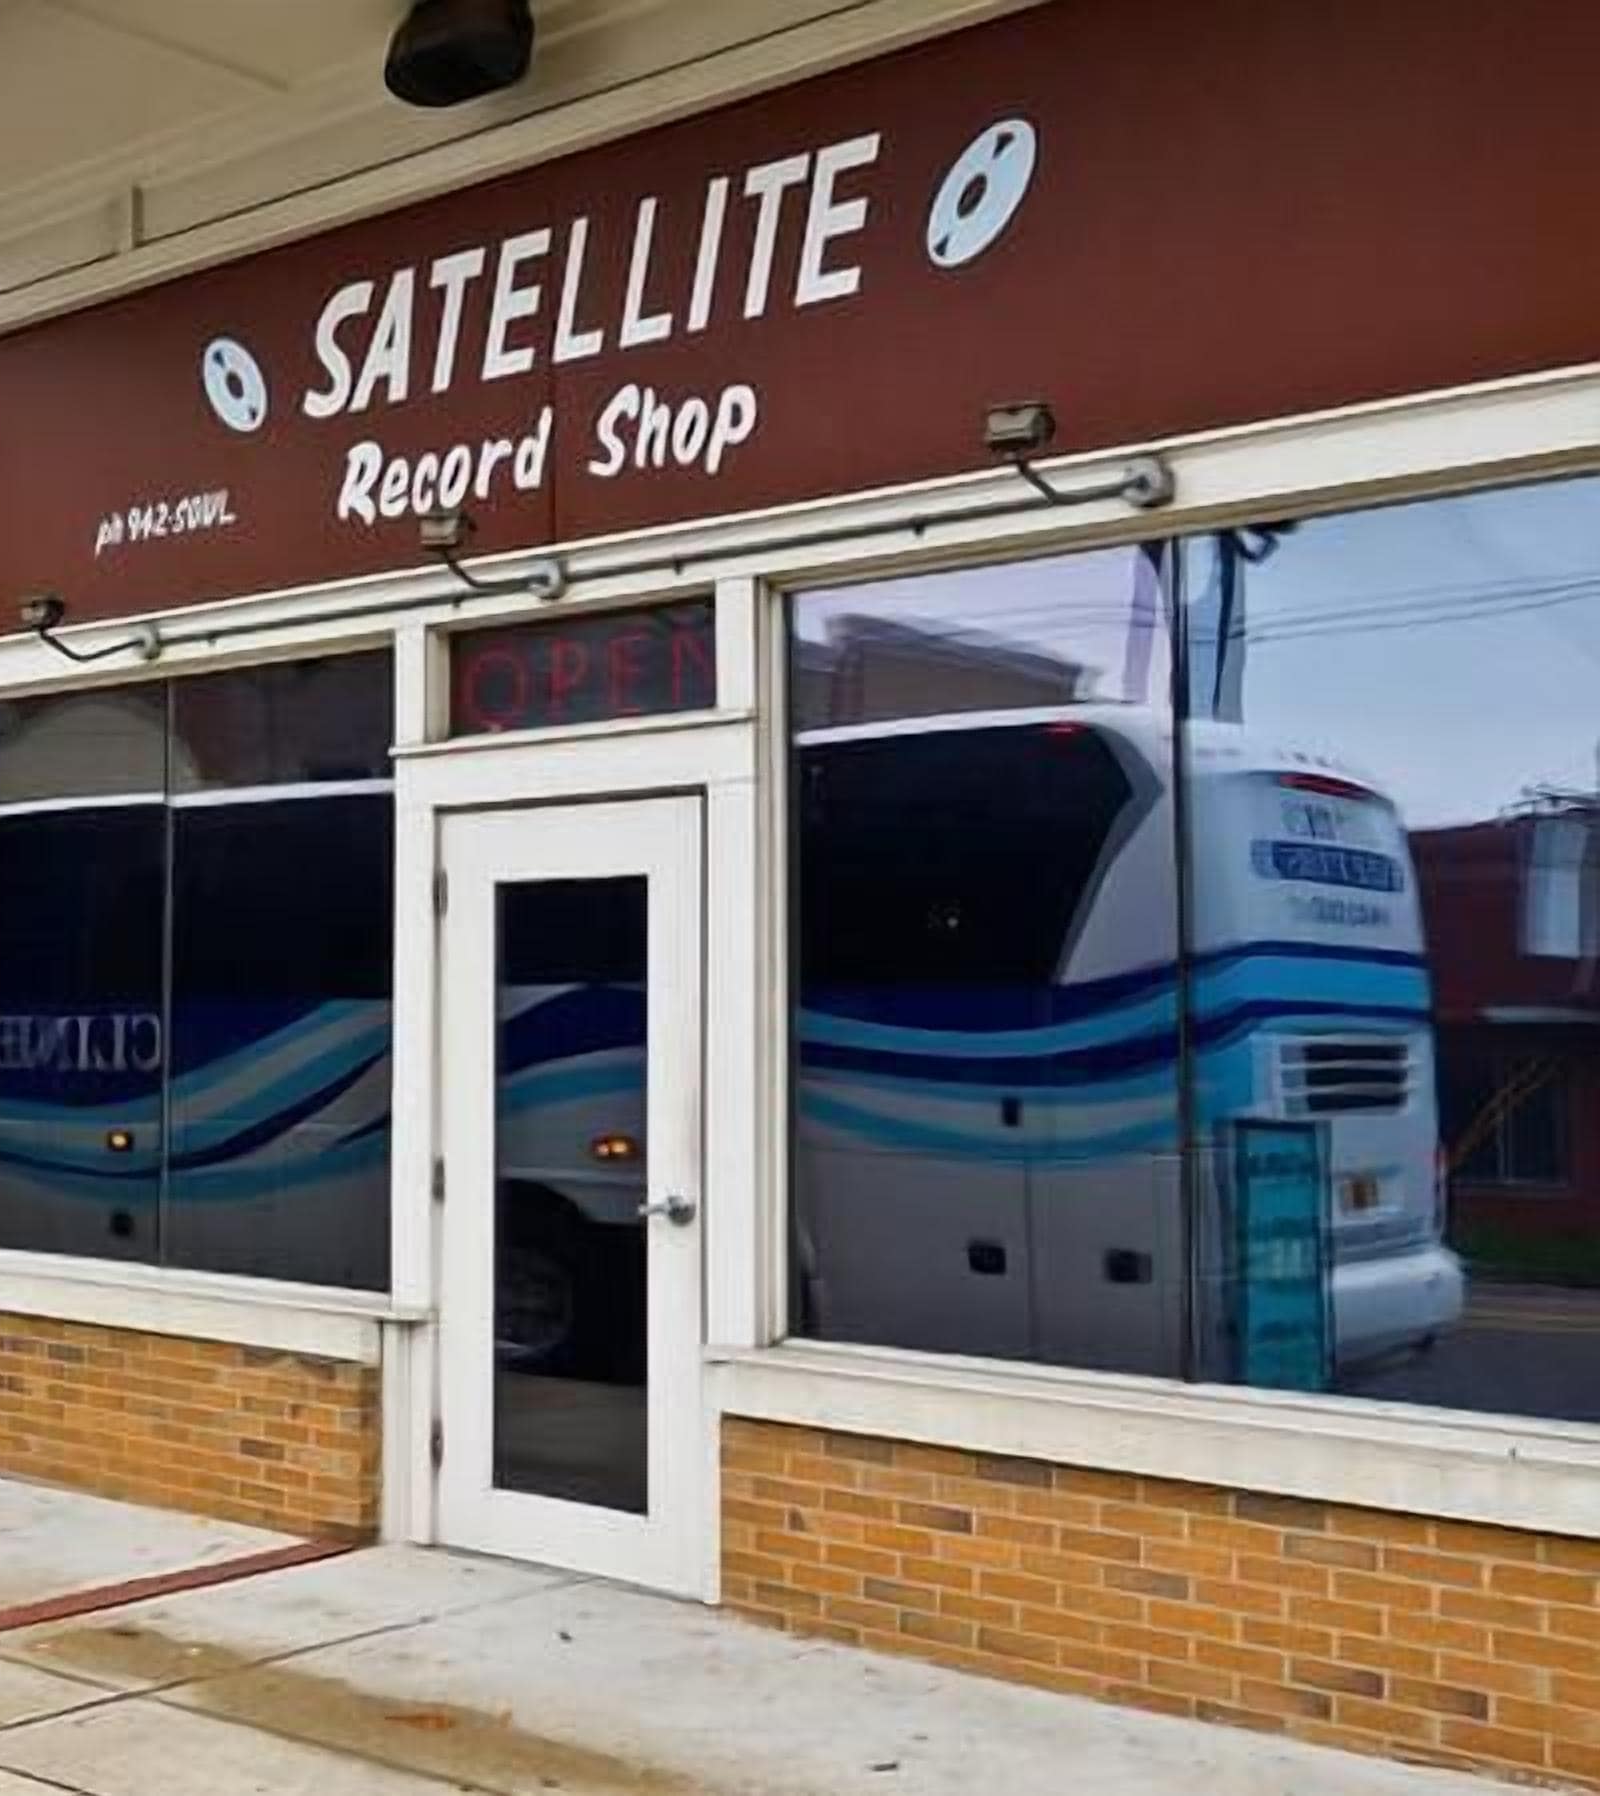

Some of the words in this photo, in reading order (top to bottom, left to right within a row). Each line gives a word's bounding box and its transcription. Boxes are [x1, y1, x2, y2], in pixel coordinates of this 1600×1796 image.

[303, 132, 881, 419] SATELLITE
[337, 405, 554, 526] Record
[589, 383, 758, 476] Shop
[460, 628, 716, 728] OPEN
